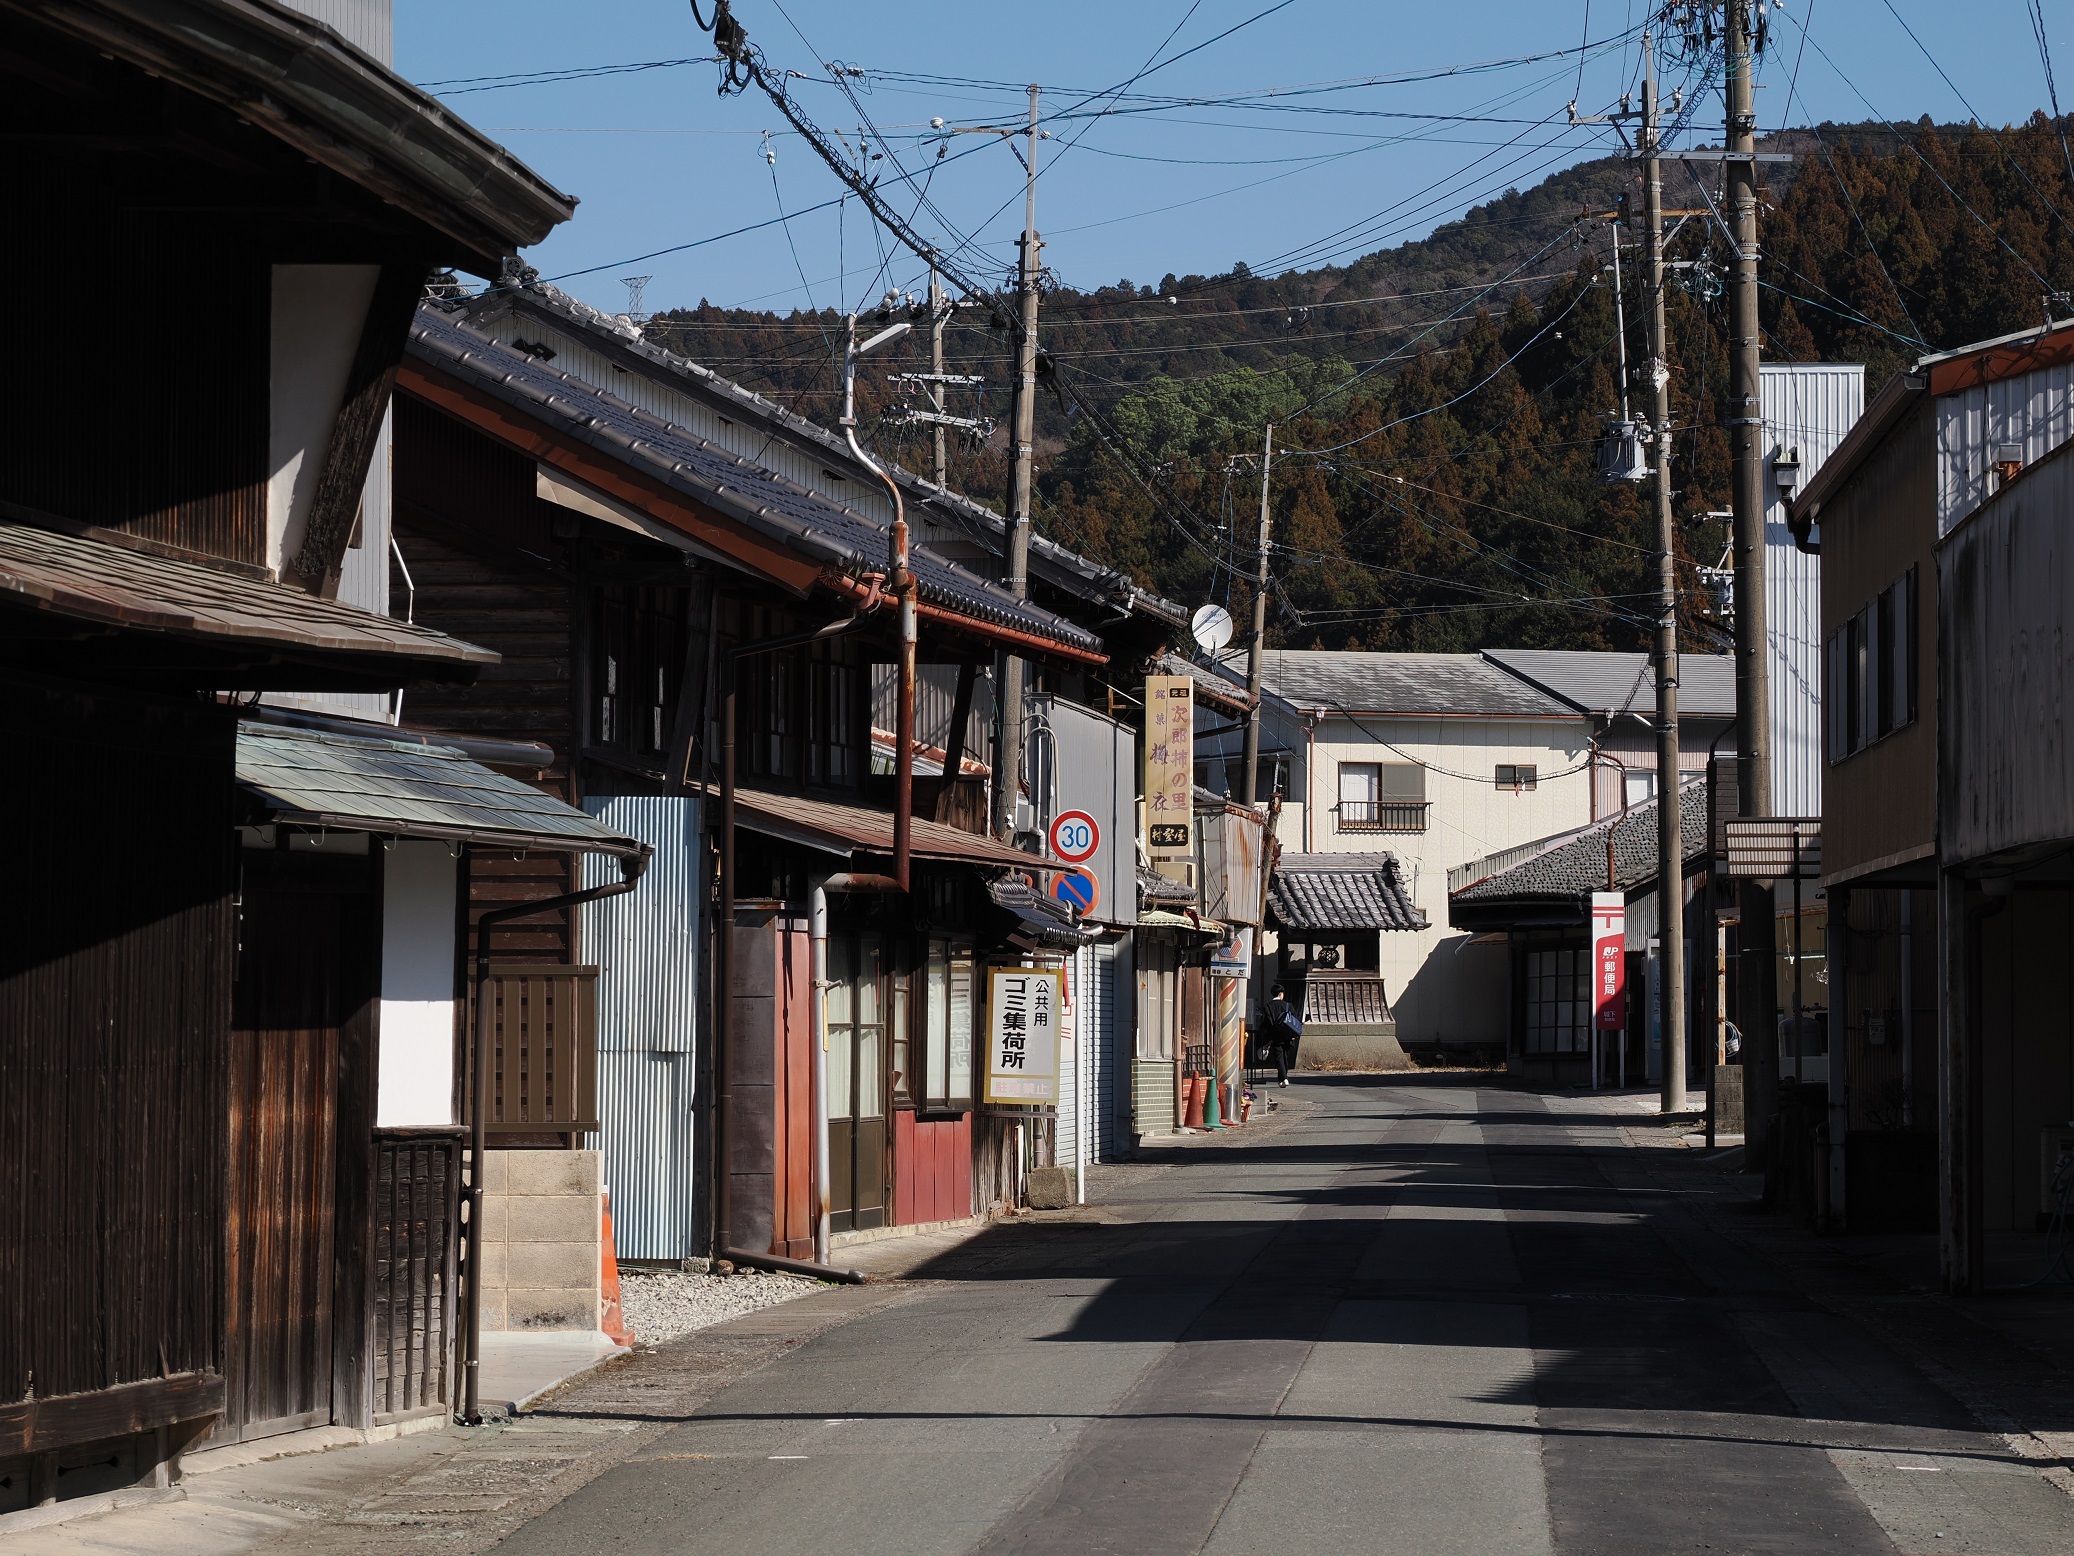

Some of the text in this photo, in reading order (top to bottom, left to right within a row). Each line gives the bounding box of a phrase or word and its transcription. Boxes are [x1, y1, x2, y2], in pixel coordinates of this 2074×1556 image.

[1171, 706, 1189, 811] 次郎柿の里
[1061, 826, 1090, 848] 30
[1604, 961, 1616, 996] 郵便局
[1001, 976, 1031, 1069] ゴミ集荷所
[1034, 979, 1049, 1026] 公共用
